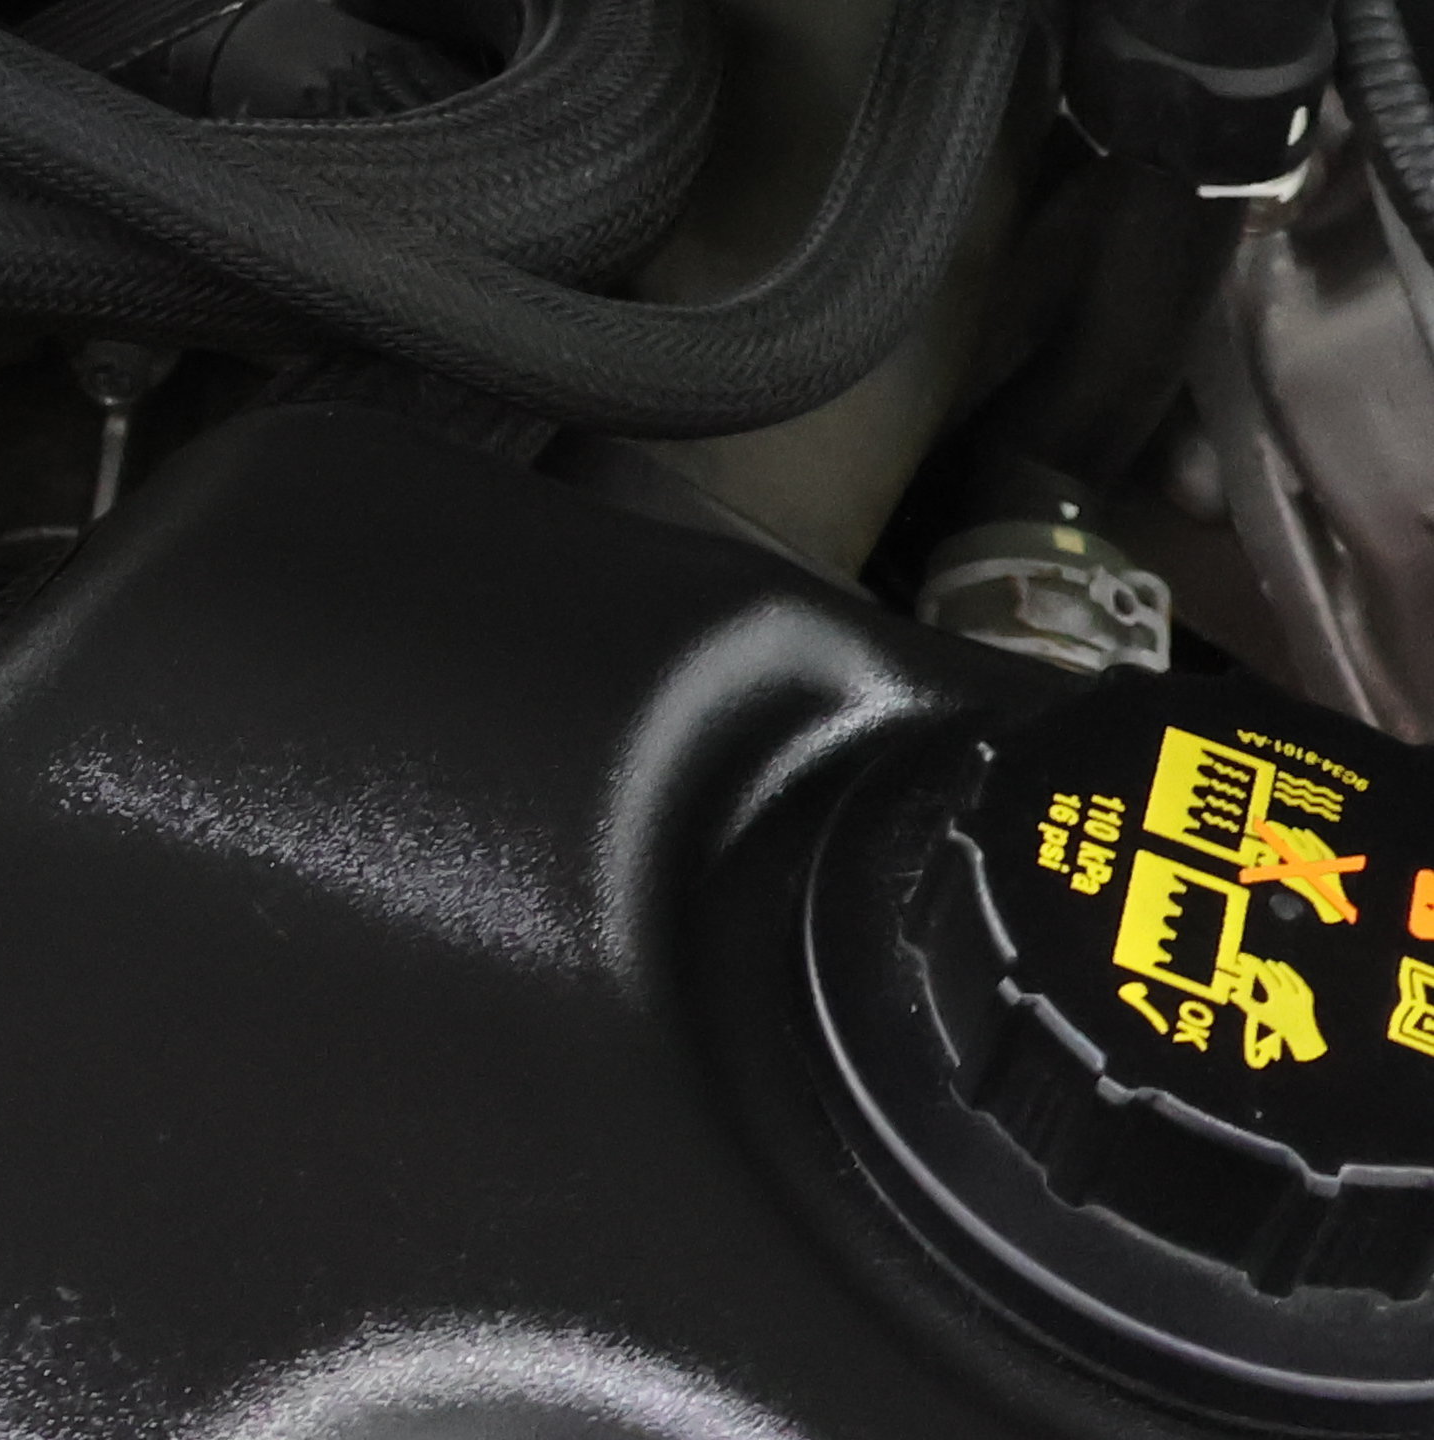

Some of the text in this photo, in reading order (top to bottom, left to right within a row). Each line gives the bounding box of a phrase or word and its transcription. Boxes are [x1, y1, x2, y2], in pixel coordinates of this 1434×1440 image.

[1037, 792, 1081, 874] 16 psi
[1070, 793, 1126, 895] 110 kPa
[1173, 1000, 1215, 1052] OK
